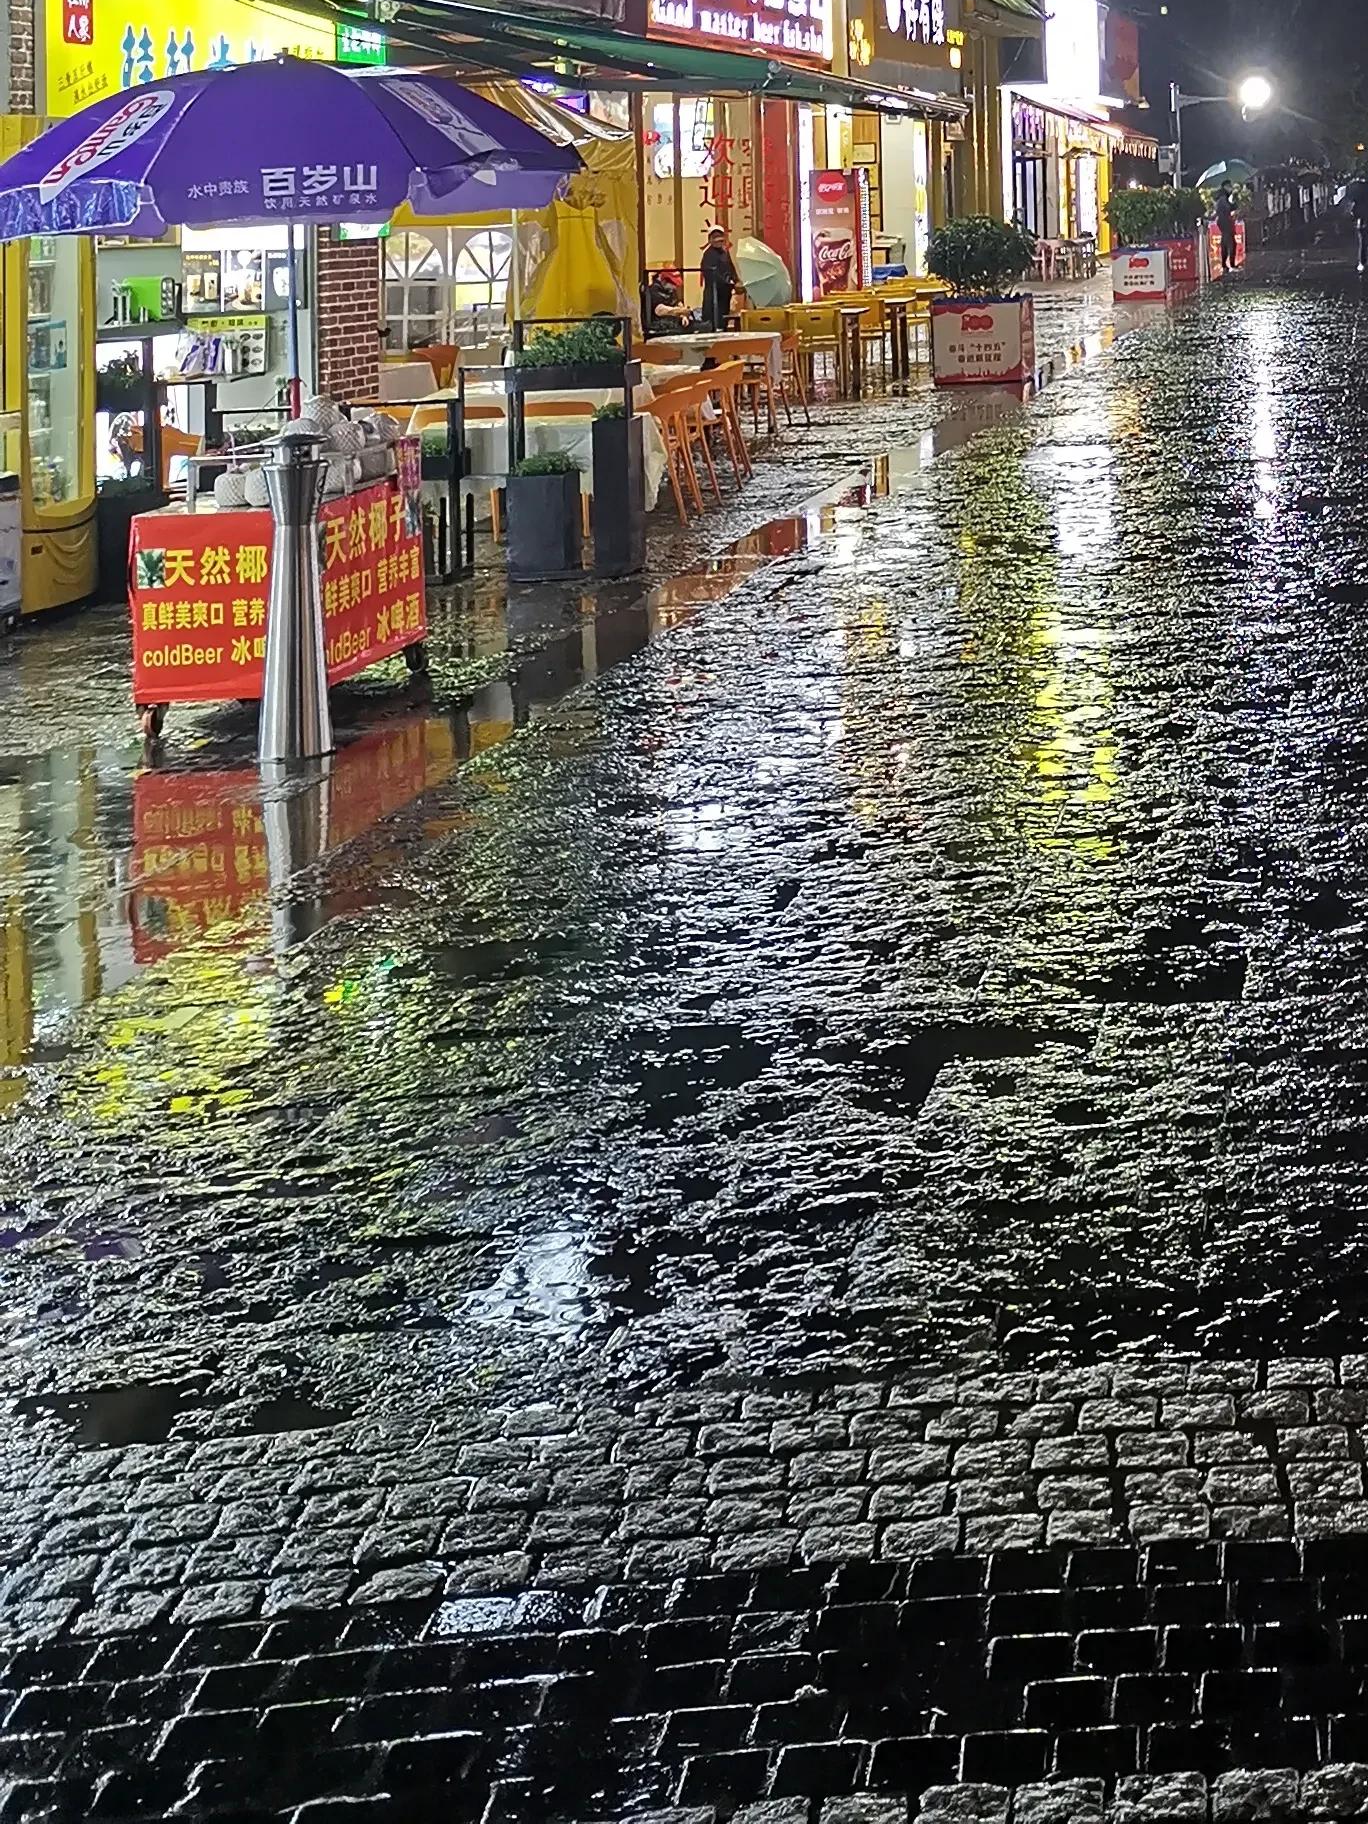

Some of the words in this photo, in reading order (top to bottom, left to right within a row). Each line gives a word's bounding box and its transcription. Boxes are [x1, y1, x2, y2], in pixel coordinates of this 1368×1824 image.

[187, 180, 250, 200] 水中贵族
[260, 163, 378, 196] 百岁山
[264, 193, 378, 210] 饮用天然矿泉水
[326, 493, 405, 571] 天然椰子
[165, 544, 268, 587] 天然椰
[322, 569, 372, 618] 鲜美爽口
[376, 545, 420, 595] 营养丰富
[142, 599, 224, 631] 真鲜美爽口
[232, 597, 266, 627] 营养
[376, 592, 420, 644] 冰啤酒
[142, 643, 225, 668] coldBeer
